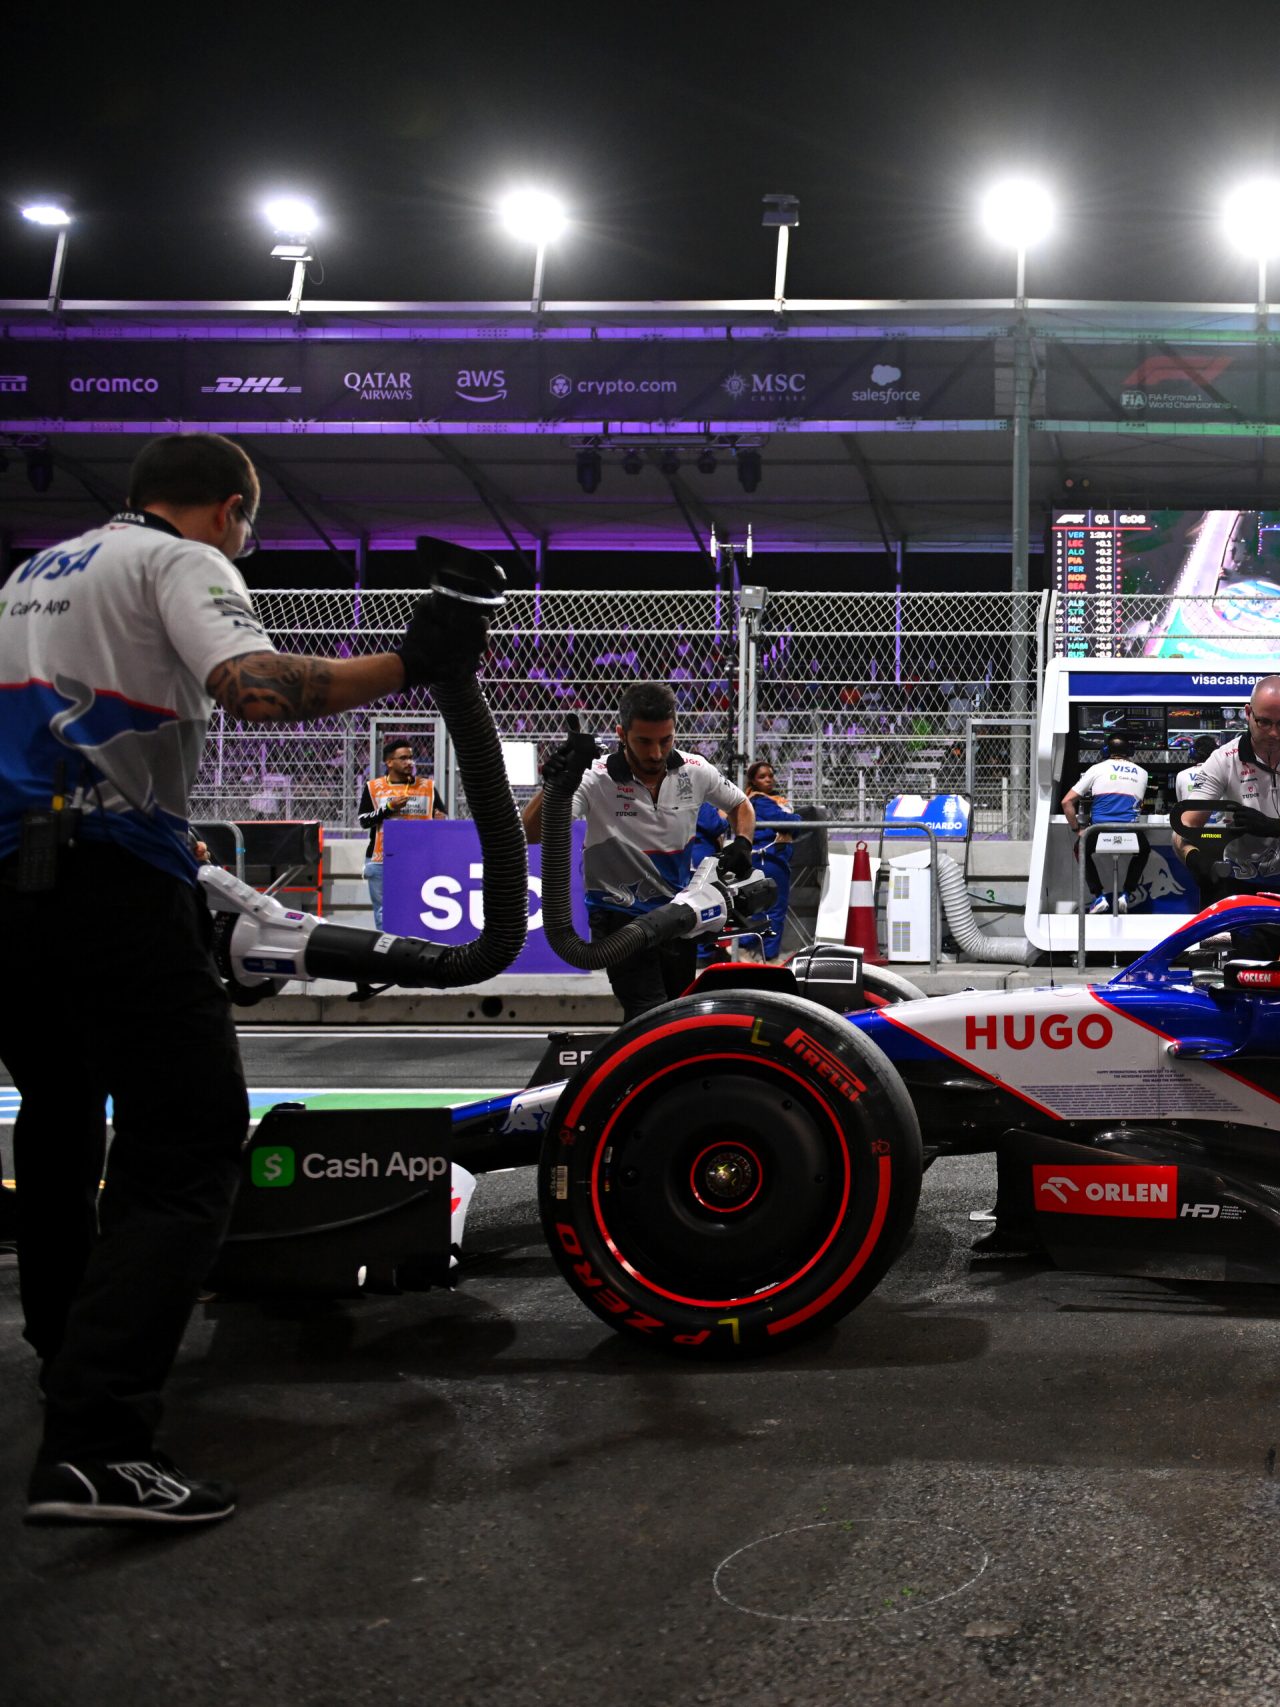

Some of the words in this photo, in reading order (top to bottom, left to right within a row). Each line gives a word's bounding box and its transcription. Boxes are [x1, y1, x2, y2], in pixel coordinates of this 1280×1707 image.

[70, 375, 158, 393] aramco
[213, 376, 292, 394] DHL
[344, 371, 411, 390] QATAR
[457, 369, 505, 389] aws
[577, 378, 677, 395] crypto.com
[751, 374, 806, 392] MSC
[361, 389, 412, 400] AIRWAYS
[851, 387, 920, 405] salesforce
[1121, 394, 1144, 406] FIA
[1163, 394, 1197, 402] Formula
[1149, 401, 1172, 409] World
[1095, 515, 1110, 525] Q1
[17, 543, 103, 583] VISA
[43, 598, 70, 615] App
[1112, 765, 1138, 775] VISA
[1243, 973, 1271, 983] ORLEN
[965, 1013, 1113, 1051] HUGO
[783, 1027, 868, 1102] PIRELLI
[303, 1152, 378, 1179] Cash
[385, 1152, 447, 1182] App
[1085, 1182, 1168, 1203] ORLEN
